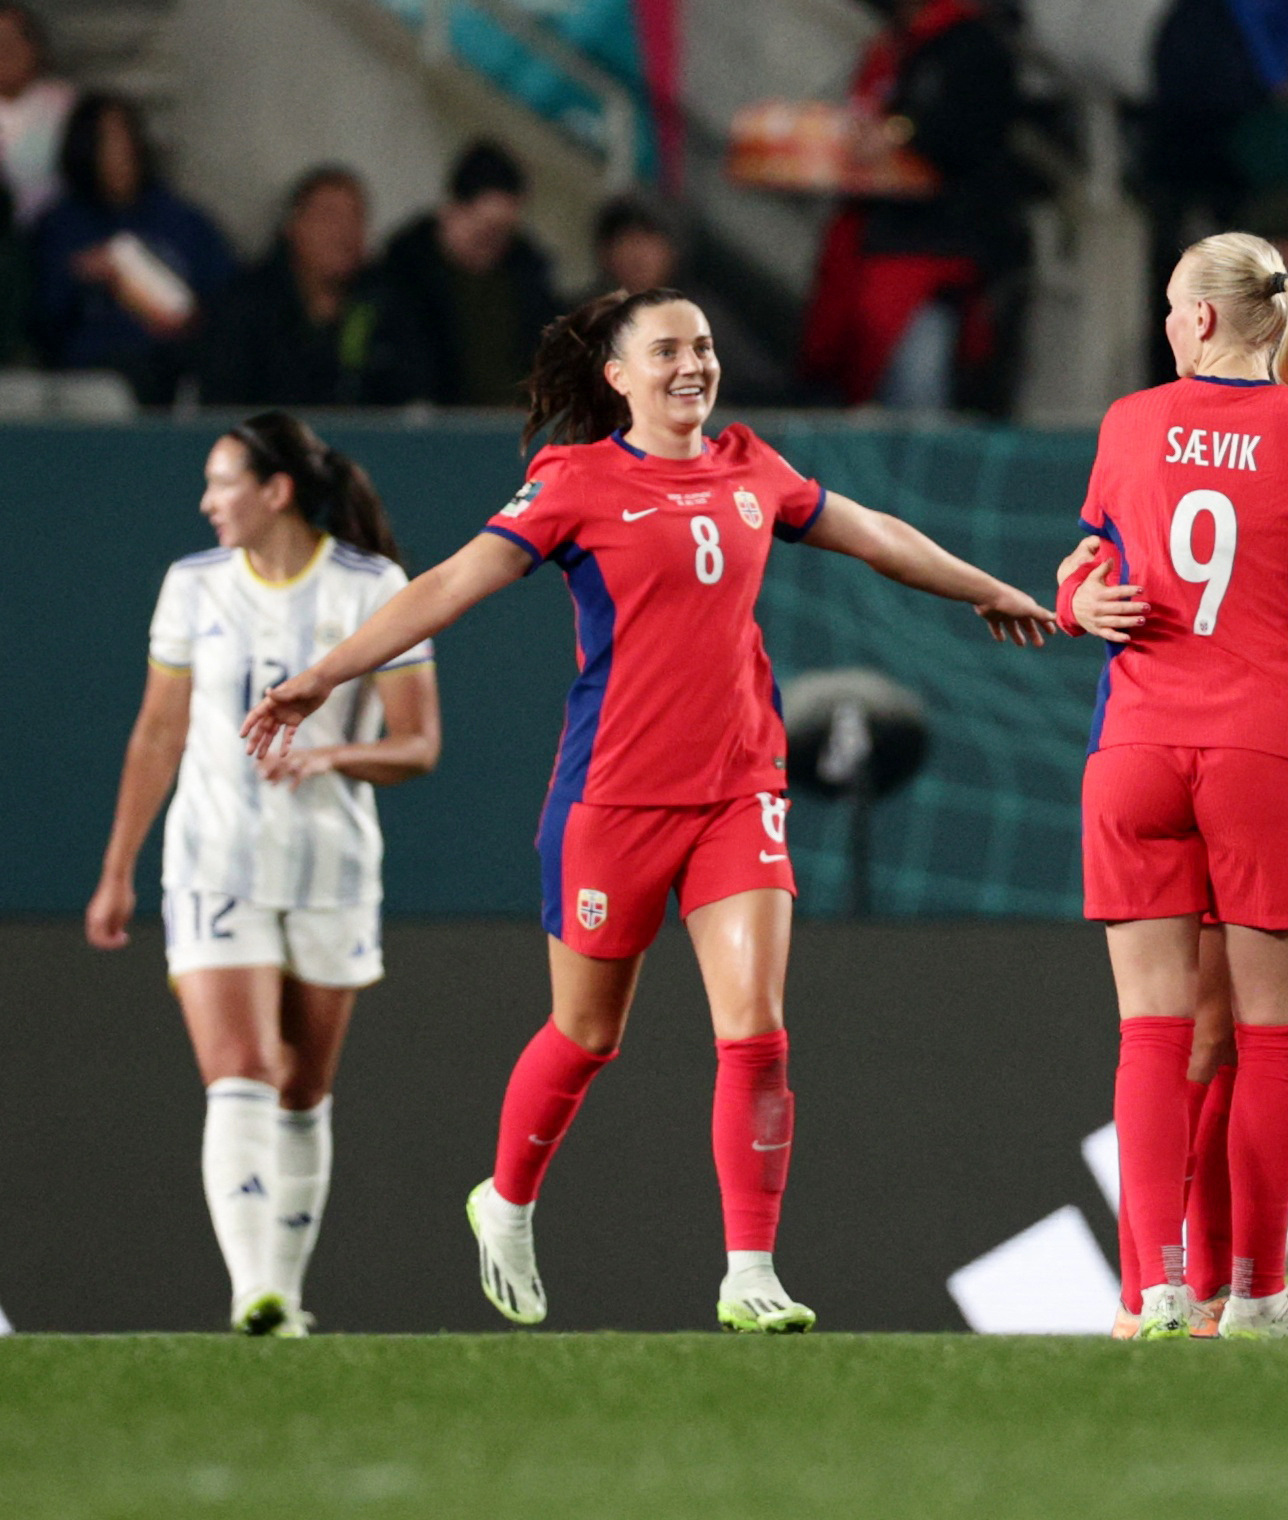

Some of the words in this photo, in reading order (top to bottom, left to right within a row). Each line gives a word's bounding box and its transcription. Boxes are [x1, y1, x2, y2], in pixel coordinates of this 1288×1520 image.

[1165, 426, 1261, 471] SÆVIK
[690, 515, 724, 585] 8
[1169, 489, 1238, 636] 9
[755, 791, 786, 843] 8
[190, 890, 237, 940] 12
